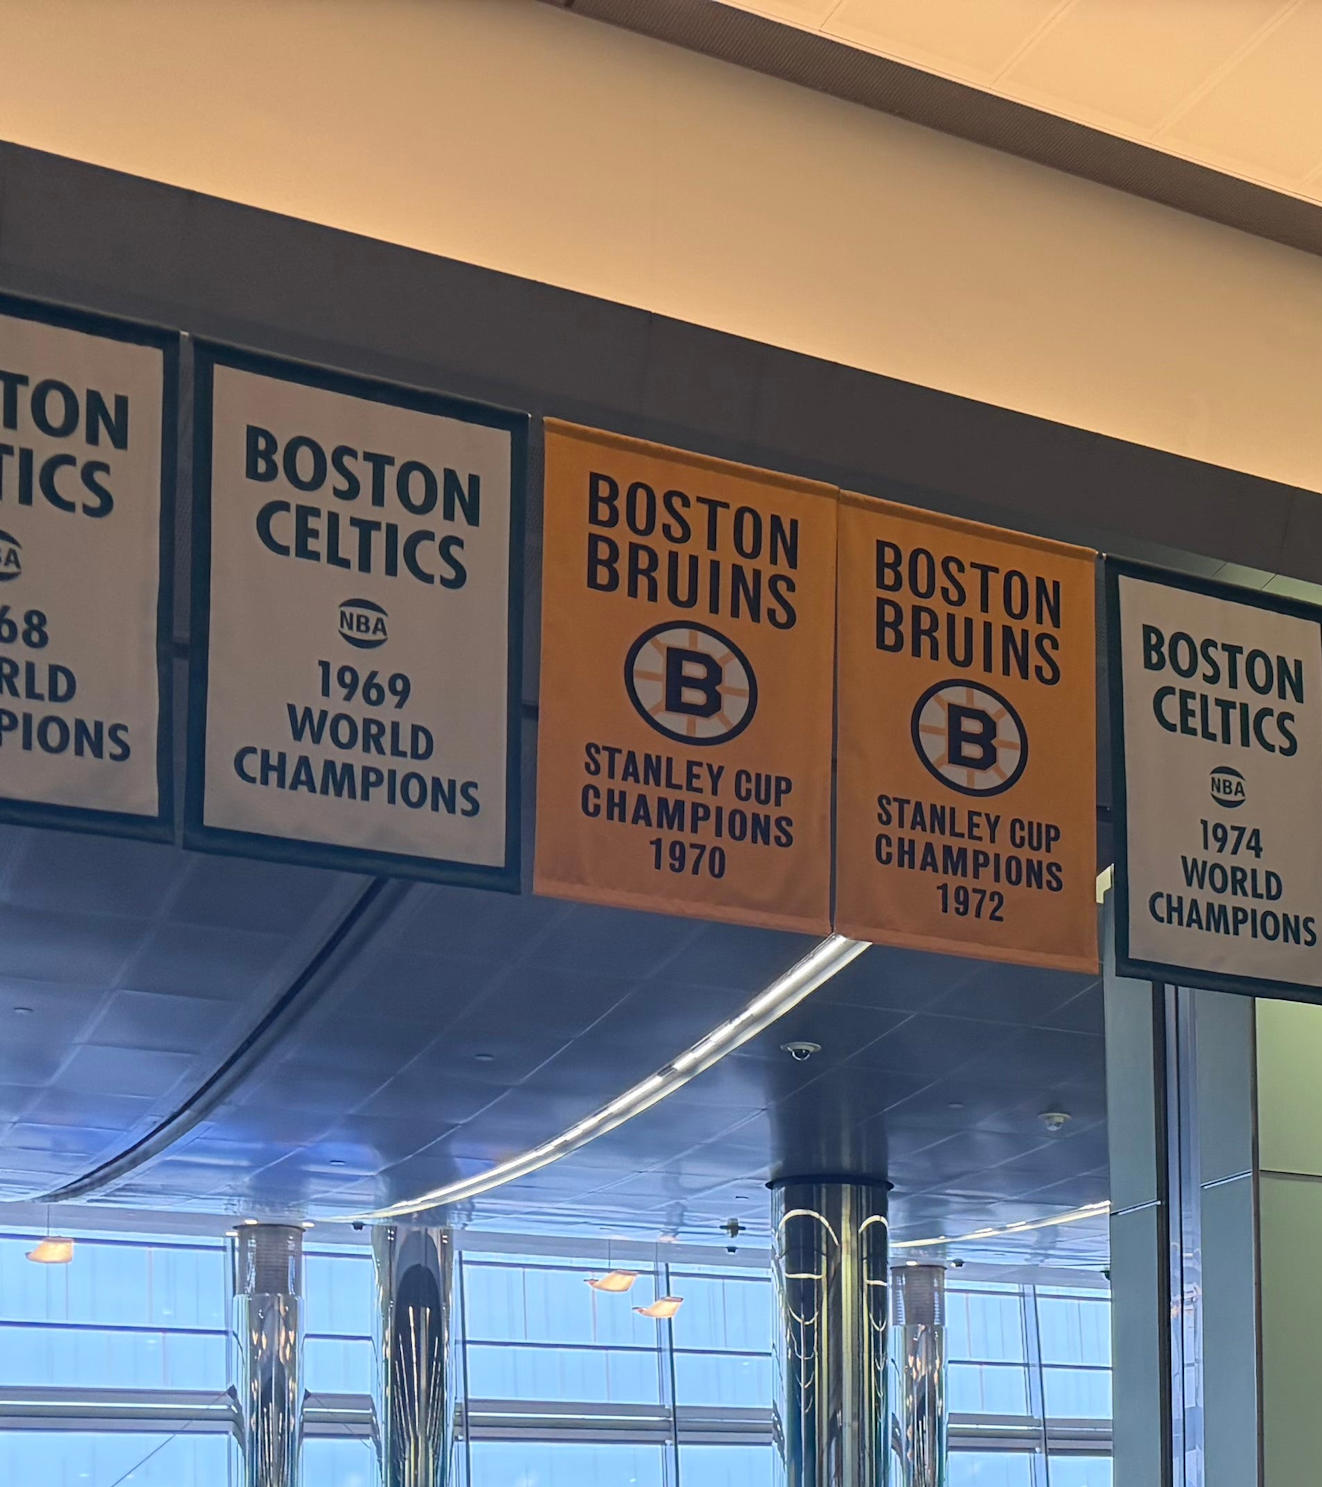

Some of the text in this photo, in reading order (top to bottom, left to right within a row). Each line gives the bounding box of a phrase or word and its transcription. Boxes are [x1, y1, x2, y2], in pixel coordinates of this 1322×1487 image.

[246, 424, 480, 527] BOSTON
[256, 500, 467, 589] CELTICS
[589, 472, 798, 570] BOSTON
[587, 533, 796, 630] BRUINS
[876, 540, 1061, 629] BOSTON
[340, 609, 387, 638] NBA
[876, 597, 1061, 685] BRUINS
[318, 660, 411, 709] 1969
[665, 646, 722, 719] B
[1143, 624, 1304, 704] BOSTON
[287, 704, 433, 761] WORLD
[947, 702, 997, 771] B
[1153, 686, 1297, 757] CELTICS
[234, 746, 480, 818] CHAMPIONS
[585, 743, 792, 807] STANLEY CUP
[1211, 777, 1245, 797] NBA
[581, 784, 794, 848] CHAMPIONS
[878, 795, 1061, 854] STANLEY CUP
[1200, 819, 1262, 859] 1974
[649, 838, 726, 879] 1970
[875, 834, 1063, 892] CHAMPIONS
[1181, 856, 1282, 901] WORLD
[937, 883, 1004, 922] 1972
[1149, 891, 1316, 947] CHAMPIONS
